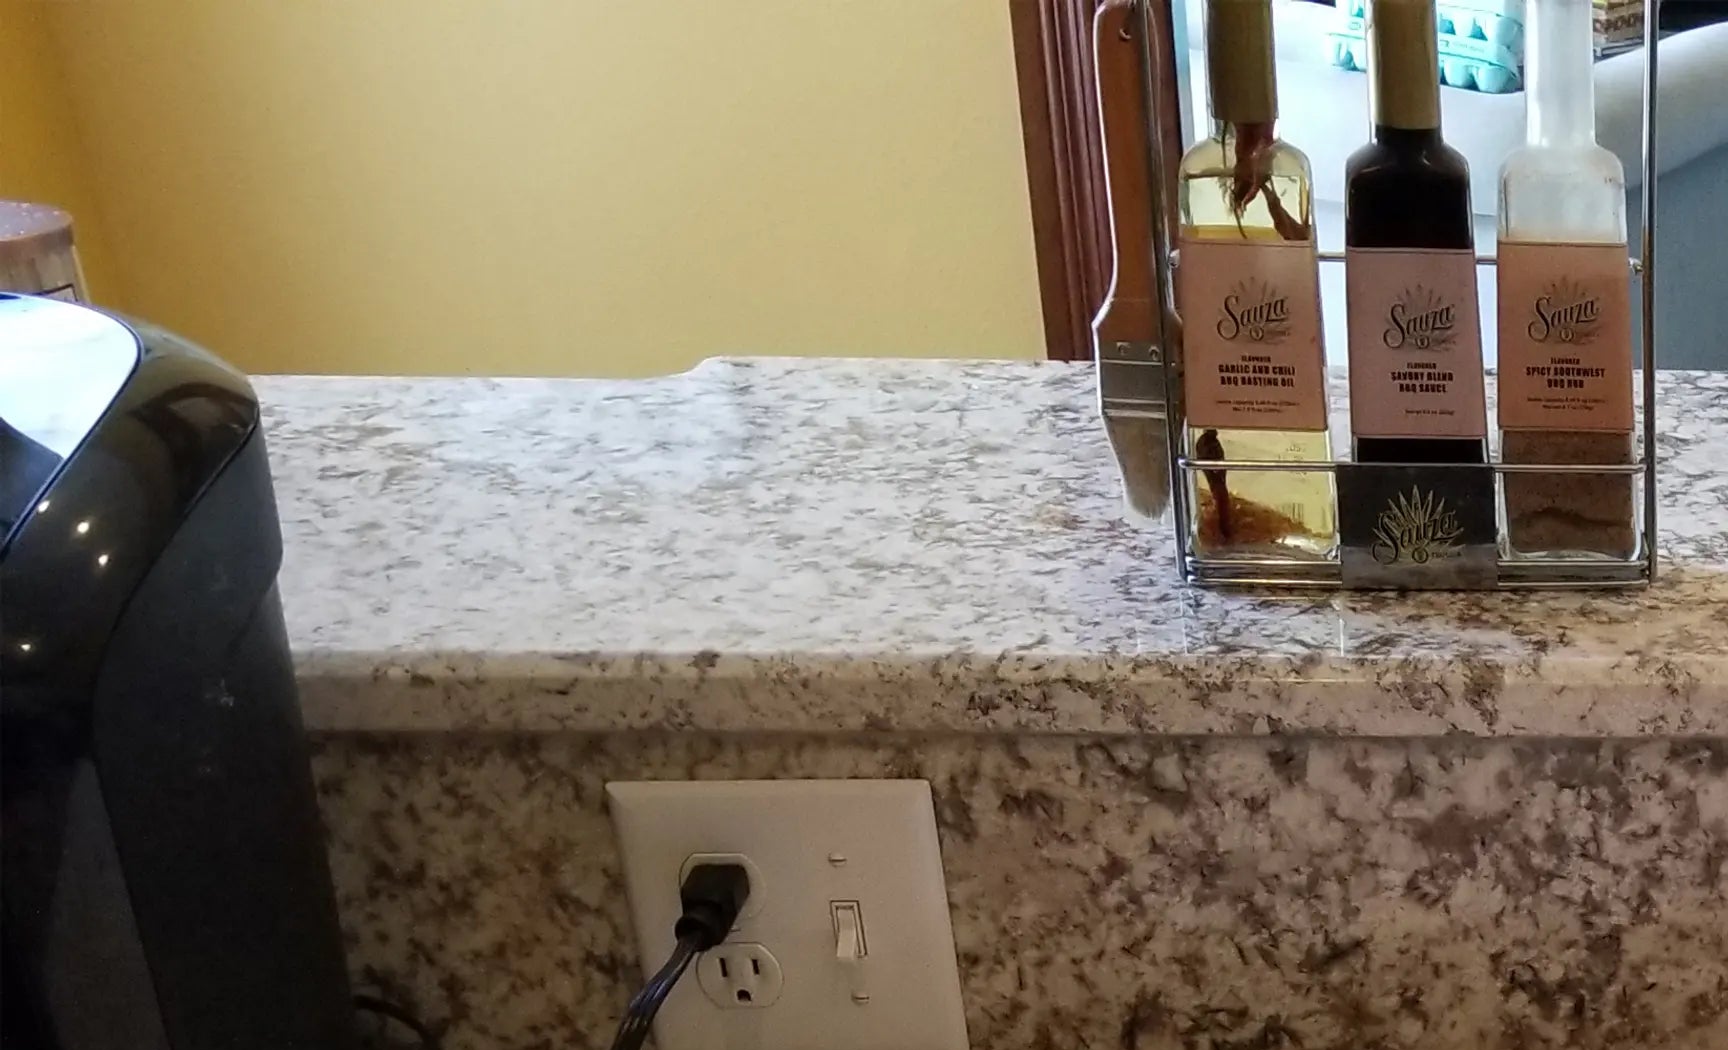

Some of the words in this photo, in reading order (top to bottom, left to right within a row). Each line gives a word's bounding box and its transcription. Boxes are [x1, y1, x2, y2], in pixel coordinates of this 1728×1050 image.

[1217, 295, 1289, 340] Sauza
[1528, 297, 1599, 342] Sauza
[1383, 303, 1455, 349] Sauza
[1218, 364, 1250, 374] GARLIC
[1252, 365, 1270, 375] AND
[1272, 366, 1296, 376] CHILI
[1390, 371, 1425, 381] SAVORY
[1426, 372, 1454, 381] BLEND
[1526, 366, 1551, 377] SPICY
[1553, 367, 1605, 378] SOUTHWEST
[1220, 376, 1239, 387] BBQ
[1241, 377, 1279, 387] BASTING
[1281, 378, 1295, 387] OIL
[1547, 378, 1565, 389] BBQ
[1567, 380, 1584, 388] RUB
[1399, 383, 1417, 394] BBQ
[1418, 384, 1447, 393] SAUCE
[1371, 510, 1462, 565] Sauza
